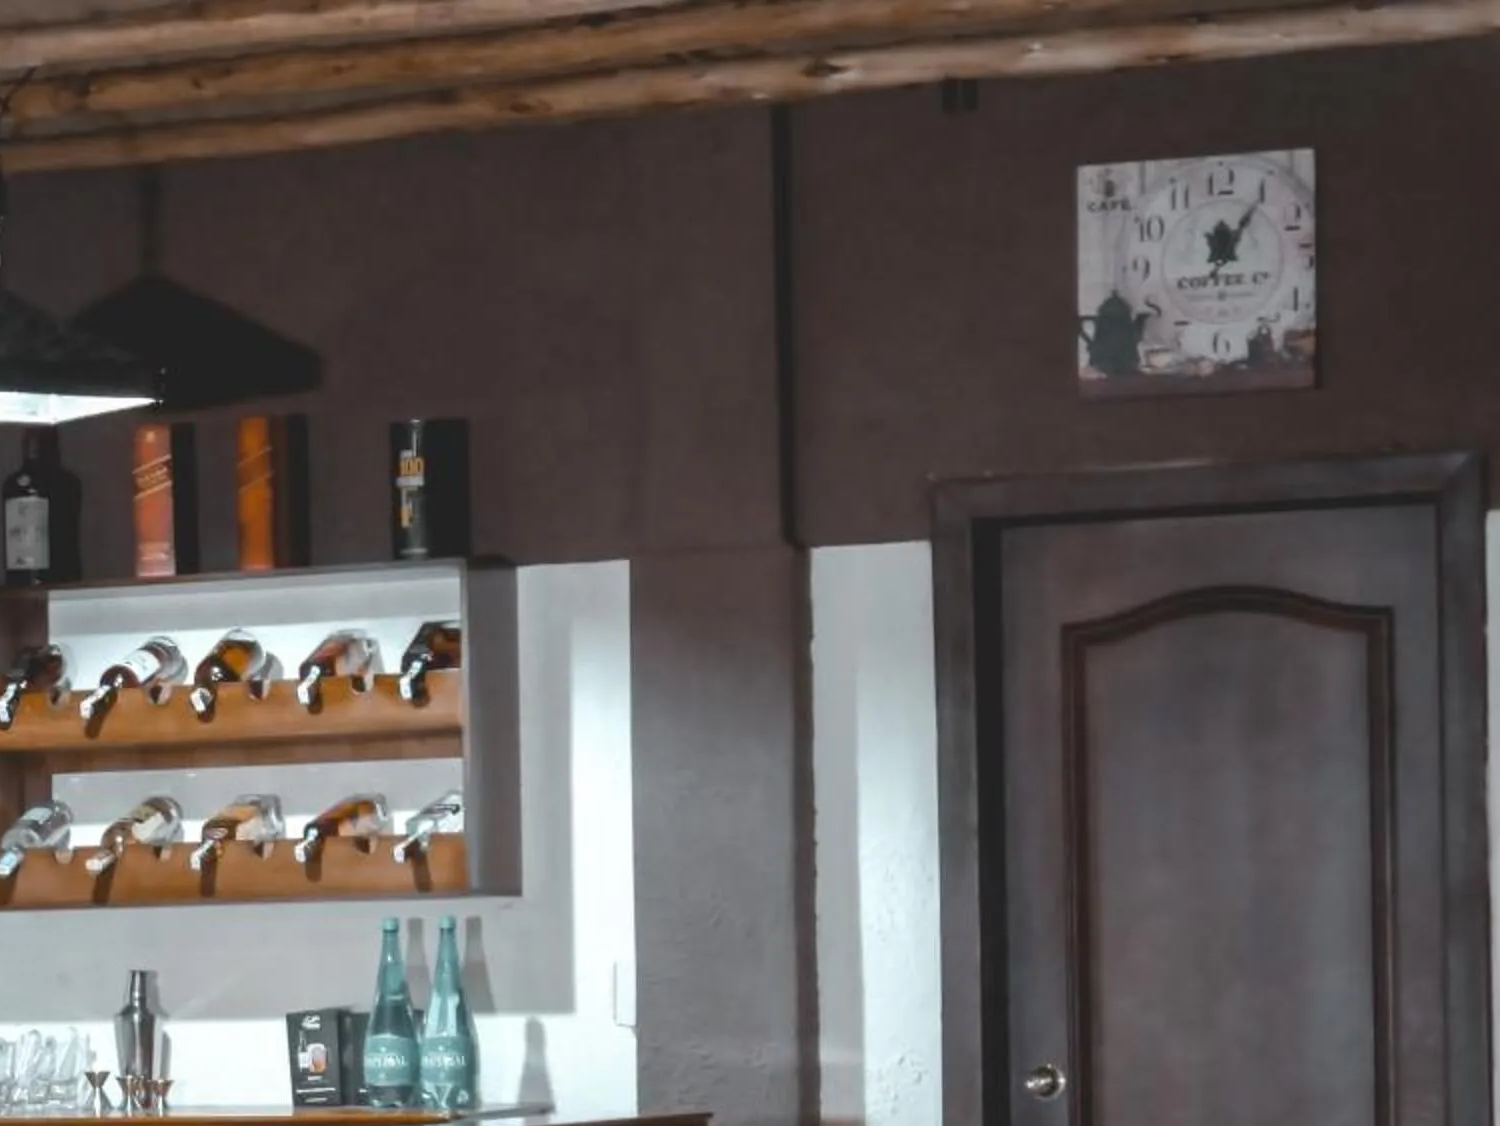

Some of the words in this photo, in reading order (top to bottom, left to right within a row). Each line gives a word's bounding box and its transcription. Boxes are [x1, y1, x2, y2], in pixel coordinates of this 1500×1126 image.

[1208, 168, 1235, 196] 12
[1170, 184, 1191, 211] 11
[1137, 215, 1165, 243] 10
[1131, 254, 1151, 283] 9
